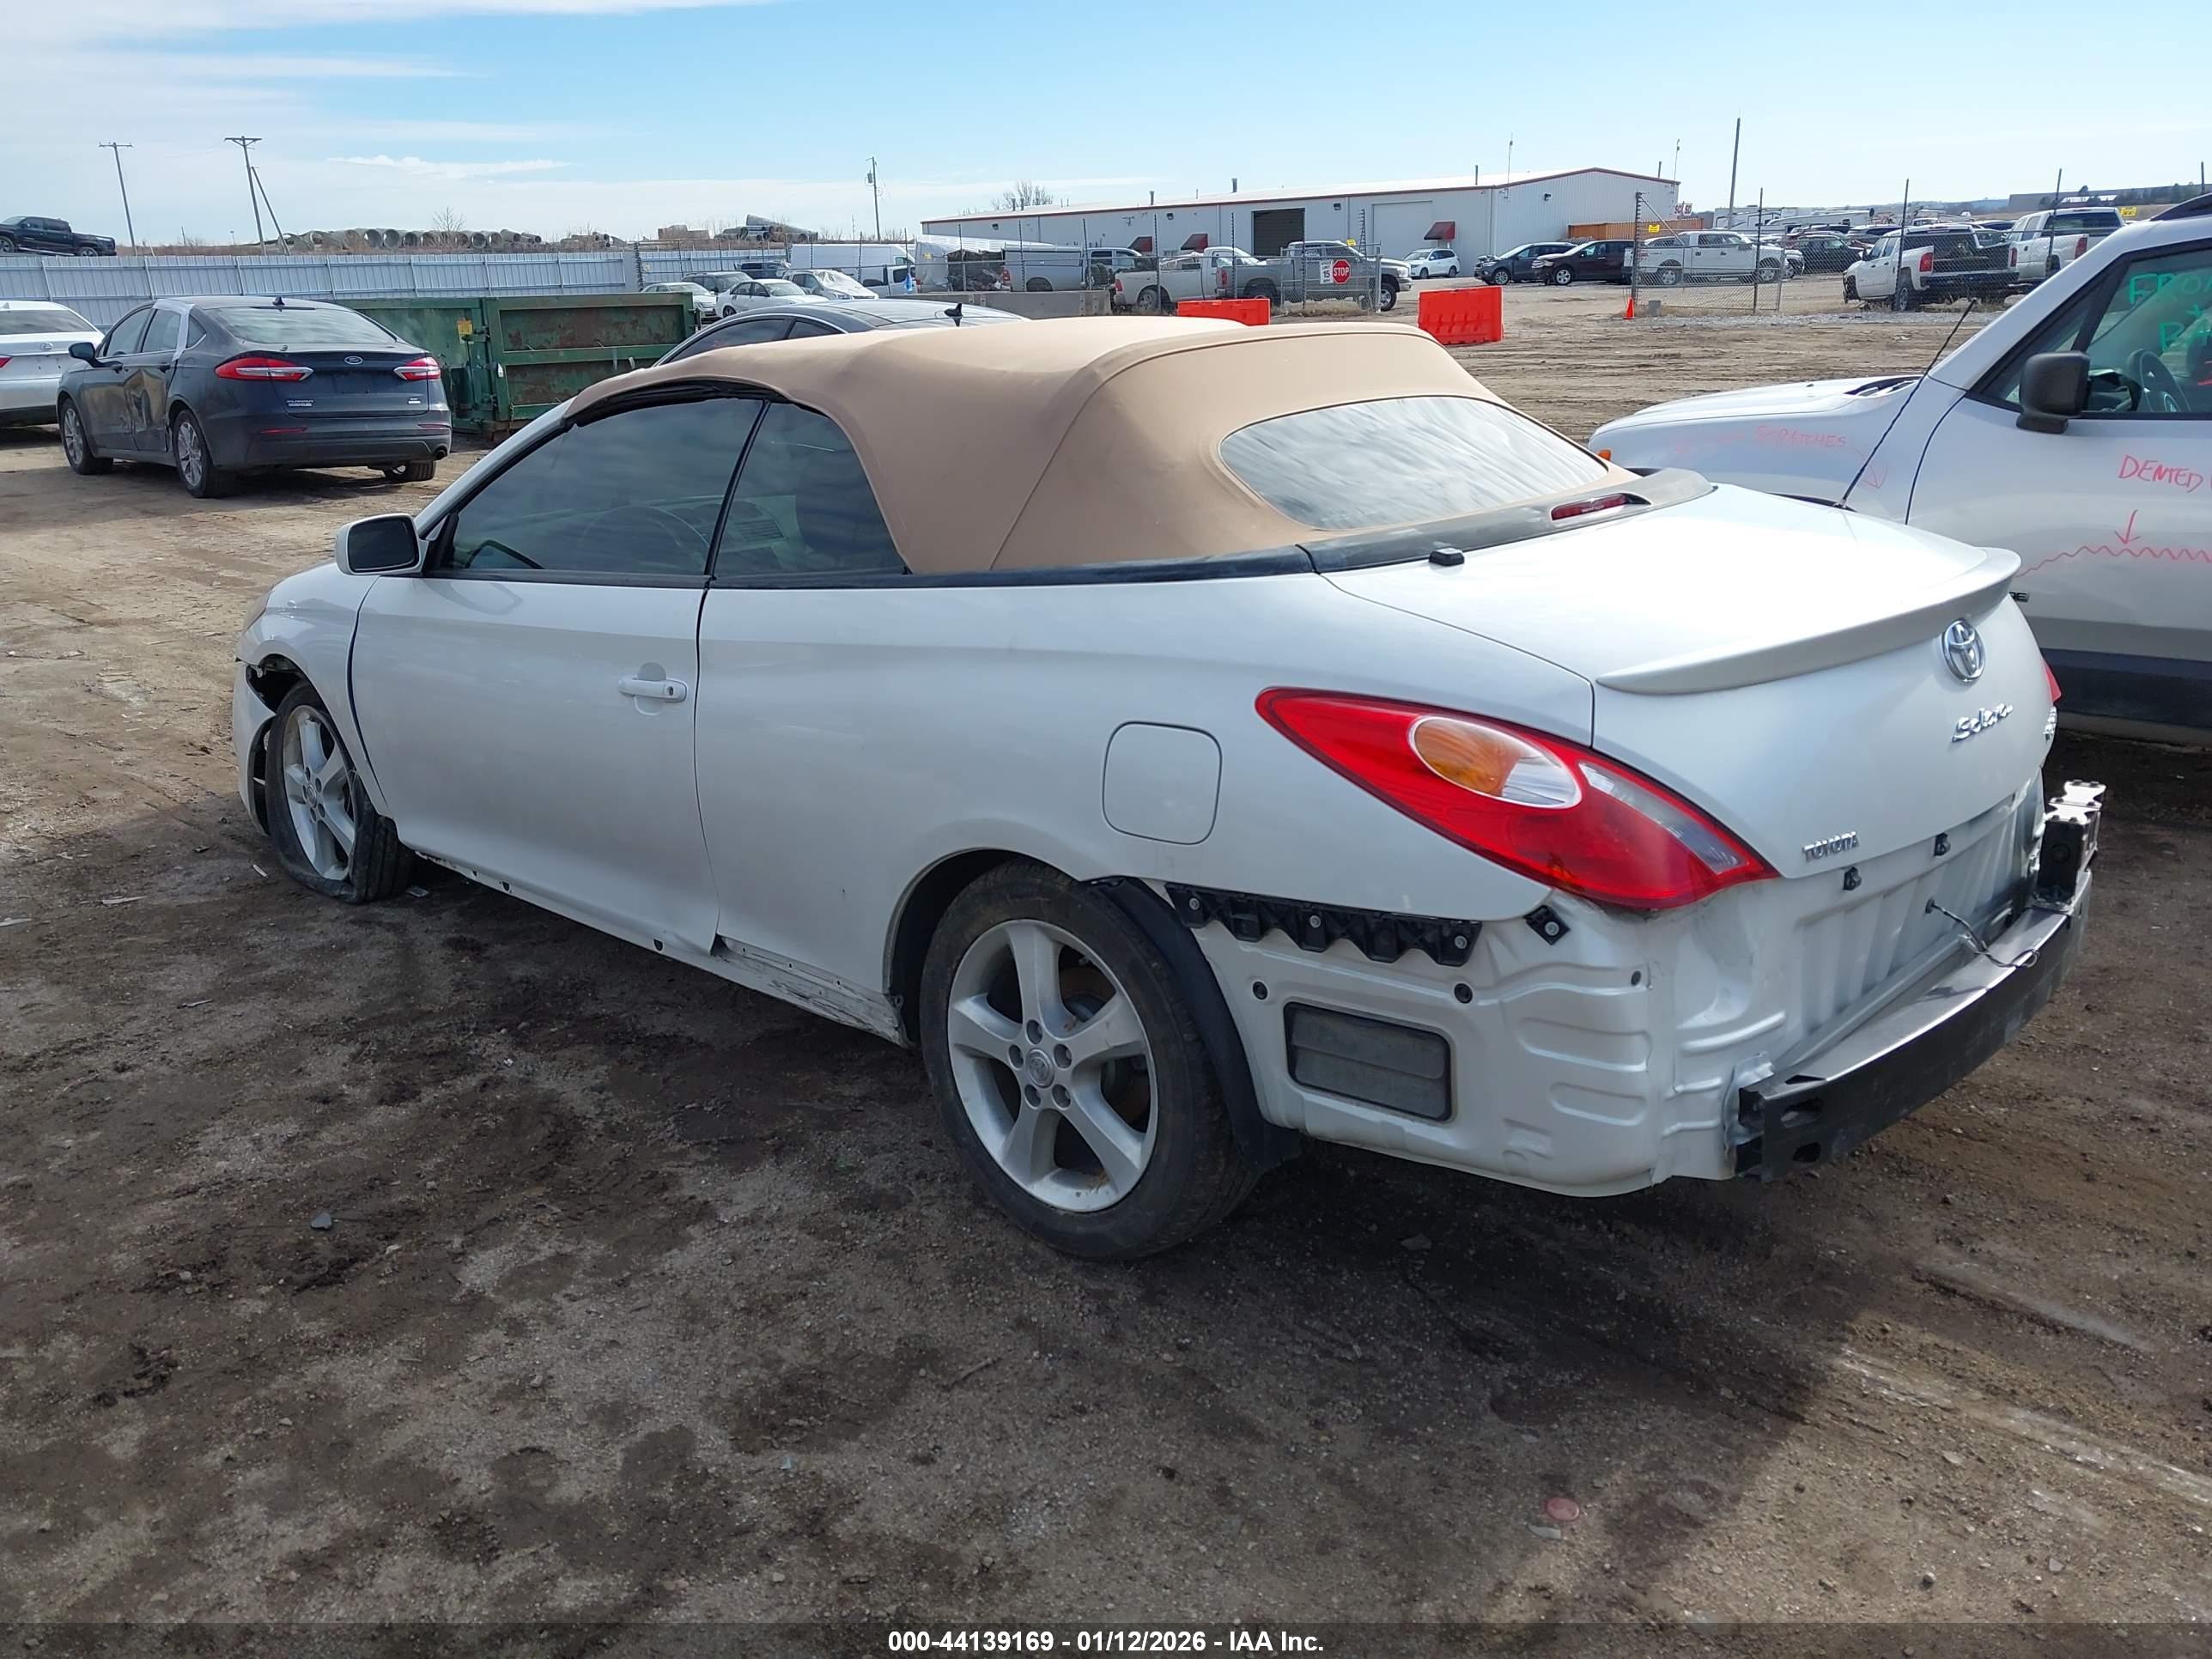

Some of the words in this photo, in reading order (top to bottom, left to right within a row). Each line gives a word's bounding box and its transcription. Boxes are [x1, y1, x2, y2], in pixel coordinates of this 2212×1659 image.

[1323, 270, 1331, 278] 15
[1333, 267, 1350, 276] STOP
[2118, 453, 2203, 493] DENTED
[1952, 703, 2014, 743] Solara
[1802, 831, 1859, 862] TOYOTA
